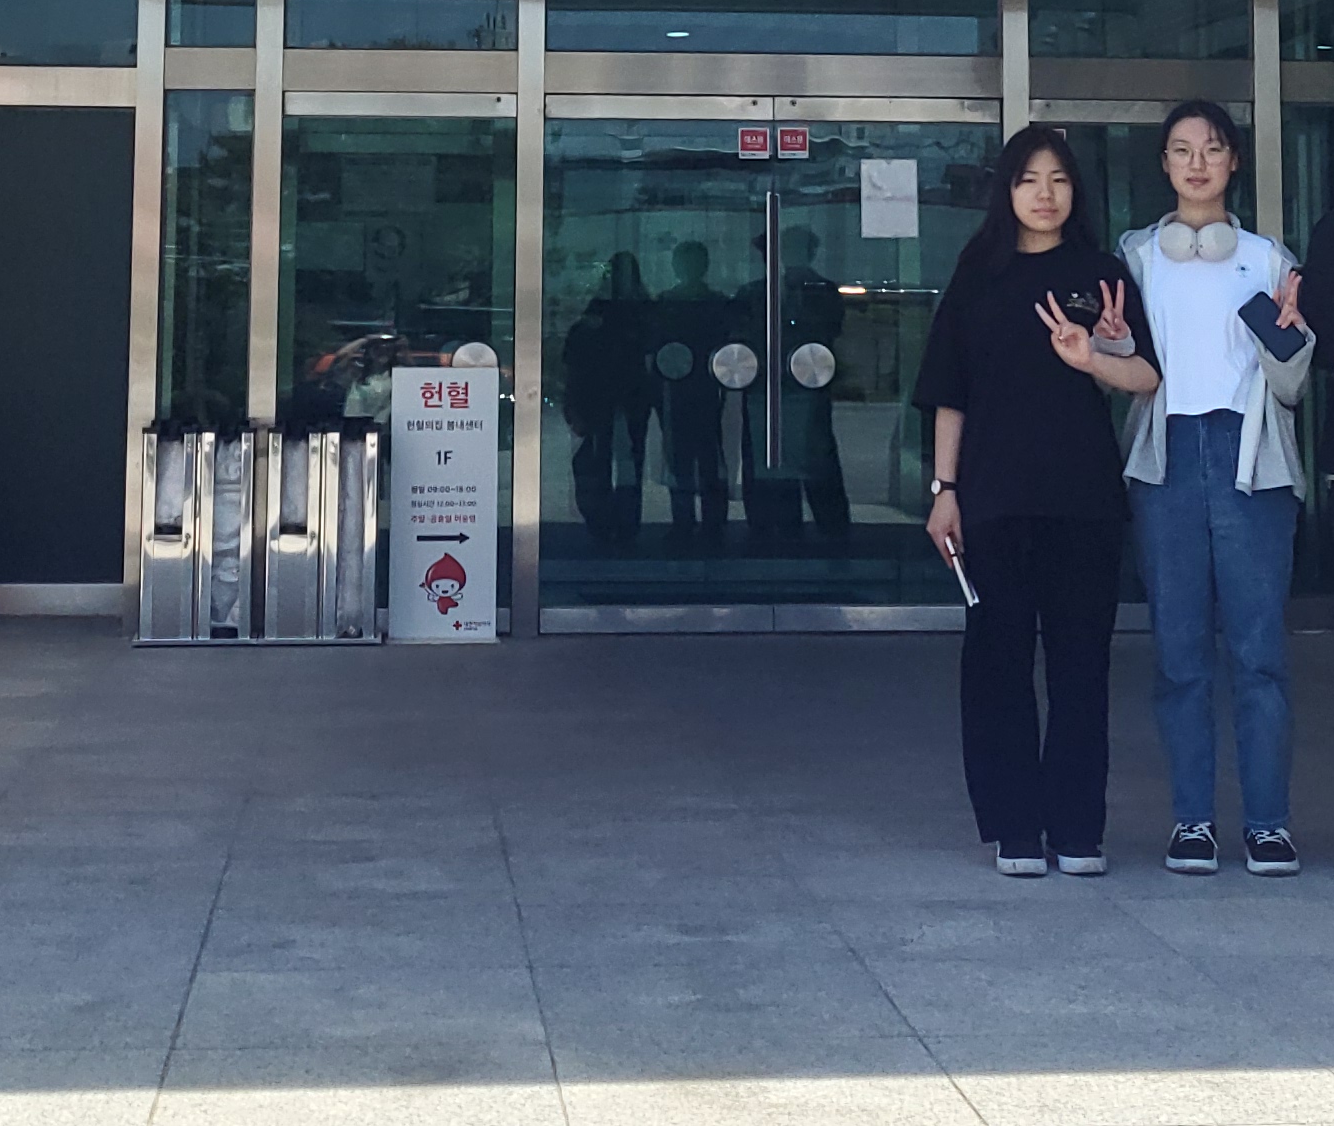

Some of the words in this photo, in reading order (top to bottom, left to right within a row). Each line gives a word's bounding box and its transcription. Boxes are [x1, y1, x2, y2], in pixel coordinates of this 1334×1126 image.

[420, 381, 470, 409] 헌혈
[407, 419, 443, 431] 헌혈의집
[436, 449, 454, 466] 1F
